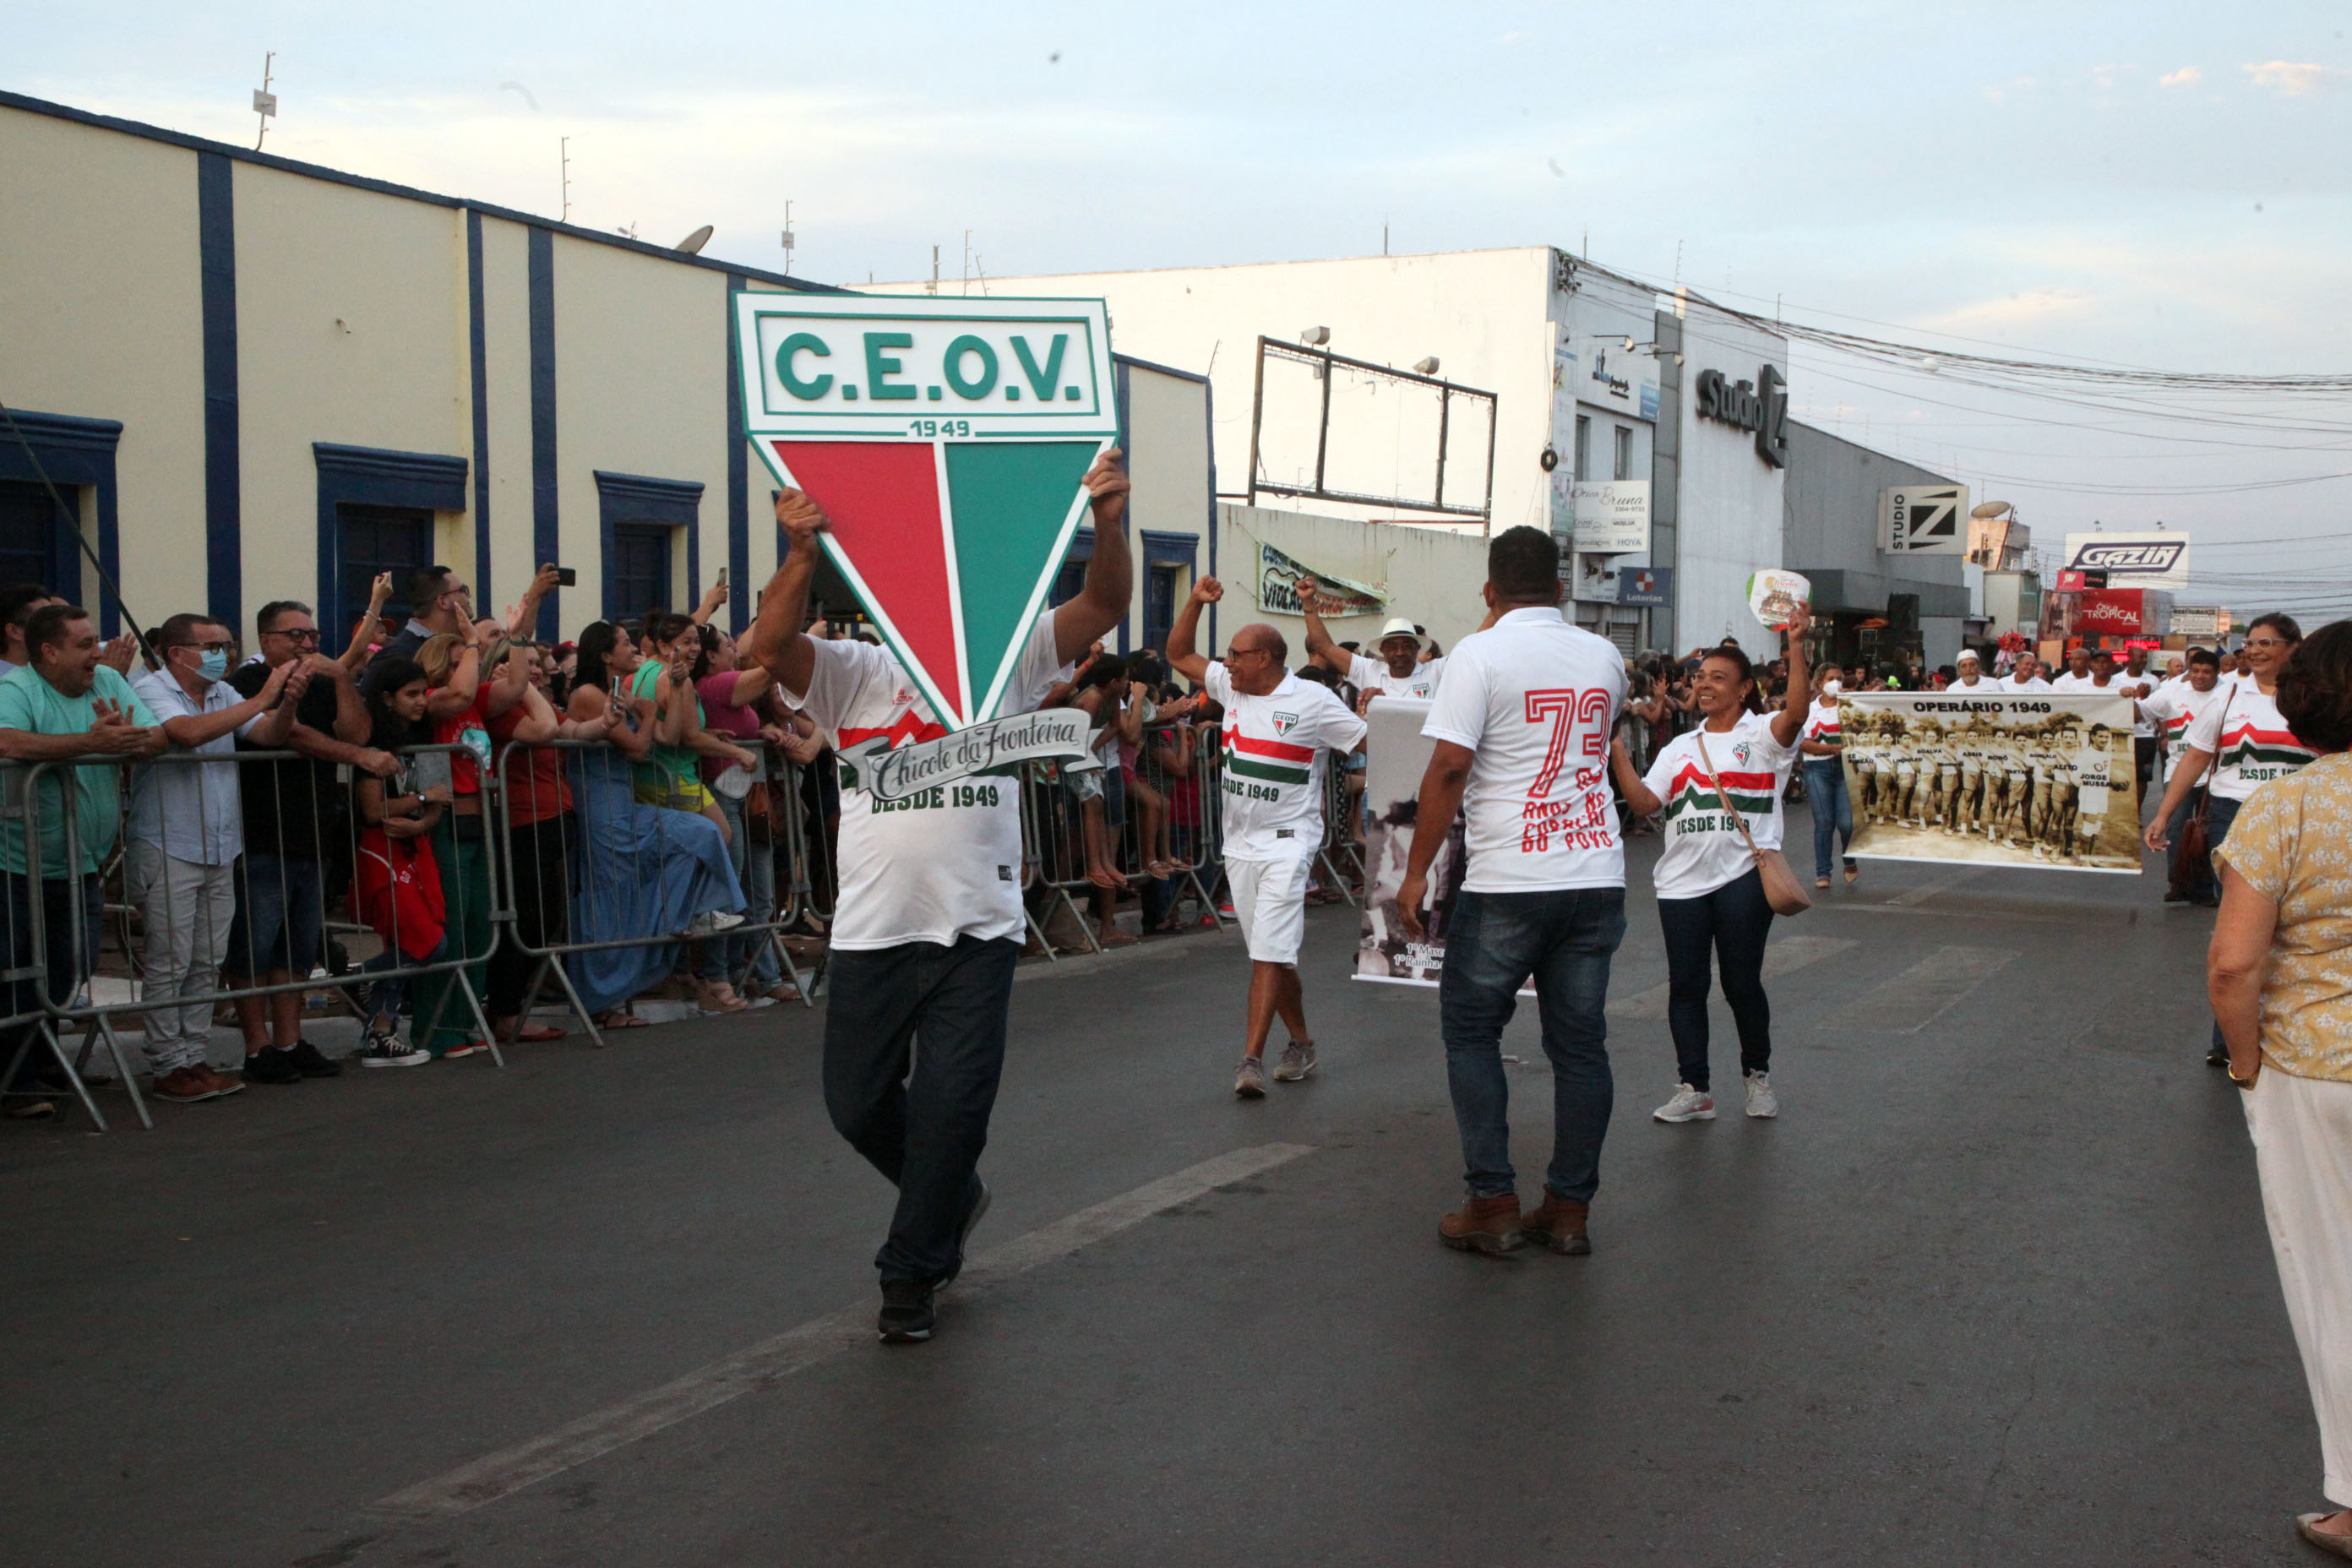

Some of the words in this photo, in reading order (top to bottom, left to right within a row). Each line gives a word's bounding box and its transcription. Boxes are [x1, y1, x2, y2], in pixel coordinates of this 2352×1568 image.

[775, 332, 1081, 401] C.E.O.V.
[910, 421, 971, 438] 1949
[1600, 486, 1643, 505] Bruna
[1892, 494, 1905, 550] STUDIO
[1626, 594, 1663, 602] Loterias
[2082, 609, 2140, 623] TROPICAL
[1914, 700, 2003, 713] OPERÁRIO
[2009, 702, 2051, 713] 1949
[957, 732, 983, 760] da
[966, 716, 1081, 772] Fronteira
[873, 740, 951, 798] Chicote
[953, 785, 999, 808] 1949
[1248, 782, 1279, 803] 1949
[1676, 815, 1715, 836] DESDE
[1522, 834, 1549, 853] DO
[1565, 830, 1614, 851] POVO
[1418, 944, 1446, 957] Masc
[1407, 955, 1439, 970] Rainha
